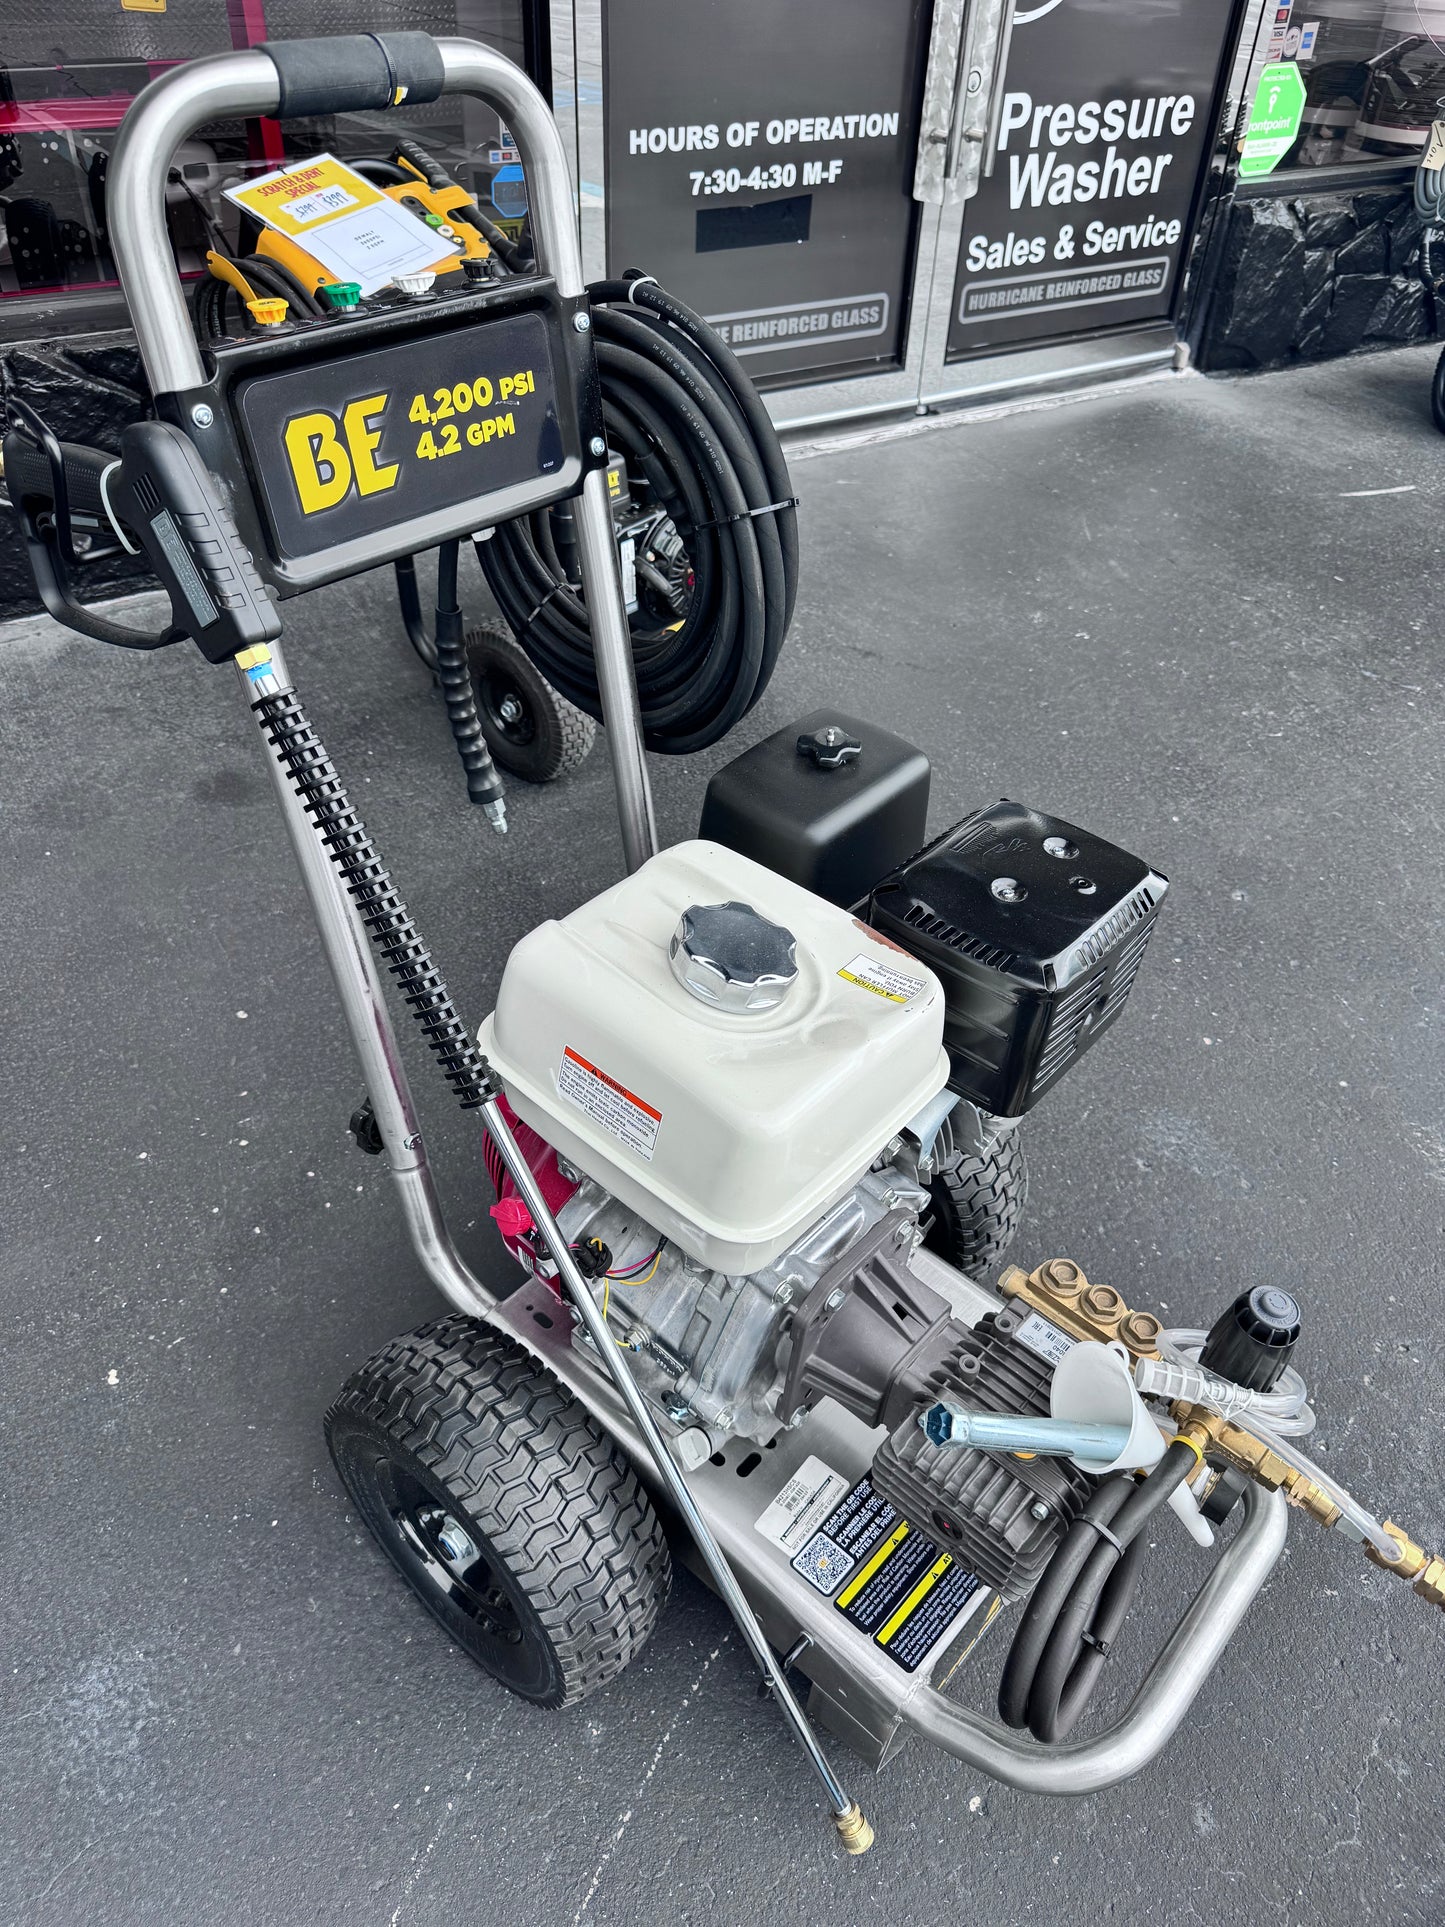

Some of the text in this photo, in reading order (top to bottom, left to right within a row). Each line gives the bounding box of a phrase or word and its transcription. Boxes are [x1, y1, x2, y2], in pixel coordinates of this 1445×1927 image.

[629, 112, 899, 154] HOURS OF OPERATION
[997, 92, 1195, 151] Pressure
[1249, 117, 1292, 134] rontpoint
[257, 174, 294, 197] SCRATCH
[303, 168, 325, 182] DENT
[284, 182, 321, 198] SPECIAL
[689, 160, 843, 196] 7:30-4:30 M-F
[1009, 146, 1173, 209] Washer
[966, 214, 1181, 272] Sales & Service
[968, 268, 1162, 311] HURRICANE REINFORCED GLASS
[732, 313, 829, 343] REINFORCED
[831, 306, 880, 328] GLASS
[408, 370, 535, 427] 4,200 PSI
[285, 394, 399, 515] BE
[416, 413, 516, 460] 4.2 GPM
[852, 977, 885, 994] CAUTION
[857, 973, 872, 981] CAN
[867, 967, 887, 977] engine
[870, 979, 898, 993] MUFFLER
[883, 980, 915, 995] BURN YOU
[563, 1062, 572, 1072] Turn
[573, 1069, 587, 1084] engine
[595, 1085, 603, 1095] and
[610, 1096, 619, 1107] cool
[620, 1104, 634, 1118] before
[564, 1055, 582, 1073] Gasoline
[587, 1073, 599, 1086] highly
[600, 1083, 623, 1103] flammable
[624, 1100, 632, 1109] and
[570, 1077, 584, 1091] engine
[585, 1088, 597, 1100] emits
[598, 1097, 608, 1108] toxic
[609, 1106, 624, 1120] carbon
[600, 1073, 626, 1096] WARNING
[559, 1083, 570, 1094] Read
[571, 1092, 587, 1107] Owner's
[588, 1105, 604, 1120] Manual
[605, 1117, 619, 1131] before
[588, 1096, 594, 1104] an
[594, 1101, 614, 1119] enclosed
[798, 1532, 807, 1542] FOR
[804, 1522, 814, 1533] SALE
[817, 1508, 825, 1517] USE
[826, 1483, 845, 1505] CALIFORNIA
[822, 1513, 838, 1532] SCAN
[835, 1502, 848, 1516] THE
[853, 1478, 869, 1496] CODE
[827, 1484, 872, 1537] BEFORE FIRST USE
[835, 1513, 860, 1543] SCANNER
[857, 1506, 867, 1517] LE
[840, 1537, 850, 1548] LA
[848, 1521, 877, 1555] ESCANEAR
[874, 1514, 883, 1524] EL
[853, 1536, 873, 1559] ANTES
[870, 1525, 883, 1540] DEL
[848, 1605, 855, 1613] To
[852, 1592, 866, 1608] reduce
[863, 1586, 871, 1595] risk
[868, 1581, 875, 1589] of
[887, 1557, 895, 1566] and
[892, 1538, 911, 1559] understand
[853, 1597, 870, 1617] ventilated
[868, 1591, 877, 1600] area
[891, 1557, 904, 1572] Carbon
[872, 1596, 881, 1605] the
[877, 1582, 892, 1599] product
[863, 1613, 875, 1626] Wear
[872, 1602, 886, 1617] proper
[882, 1591, 894, 1604] safety
[889, 1638, 899, 1650] Pour
[903, 1652, 913, 1663] Eau
